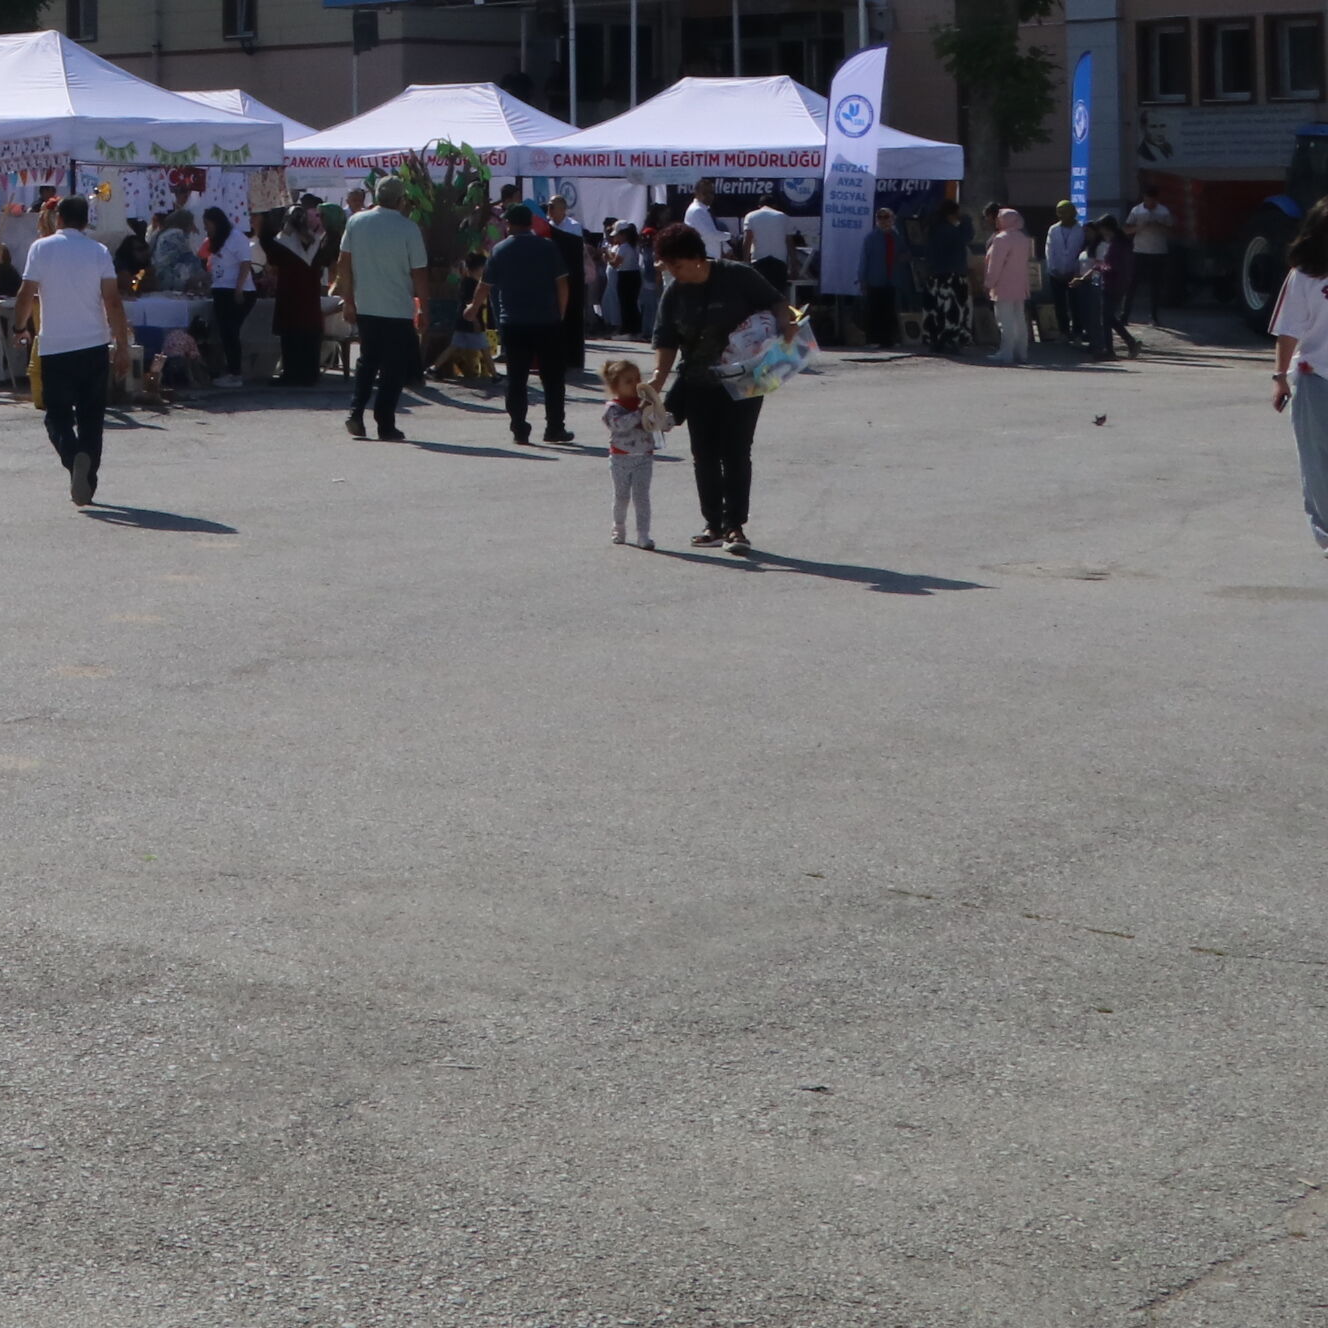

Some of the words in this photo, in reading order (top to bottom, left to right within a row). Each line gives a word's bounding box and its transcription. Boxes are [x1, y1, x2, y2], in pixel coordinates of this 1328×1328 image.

[553, 153, 610, 168] ÇANKIRI
[615, 150, 626, 167] İL
[671, 151, 720, 167] EĞİTİM
[724, 149, 821, 168] MÜDÜRLÜĞÜ
[832, 163, 869, 173] NEVZAT
[837, 177, 863, 187] AYAZ
[830, 190, 867, 201] SOSYAL
[825, 202, 870, 215] BİLİMLER
